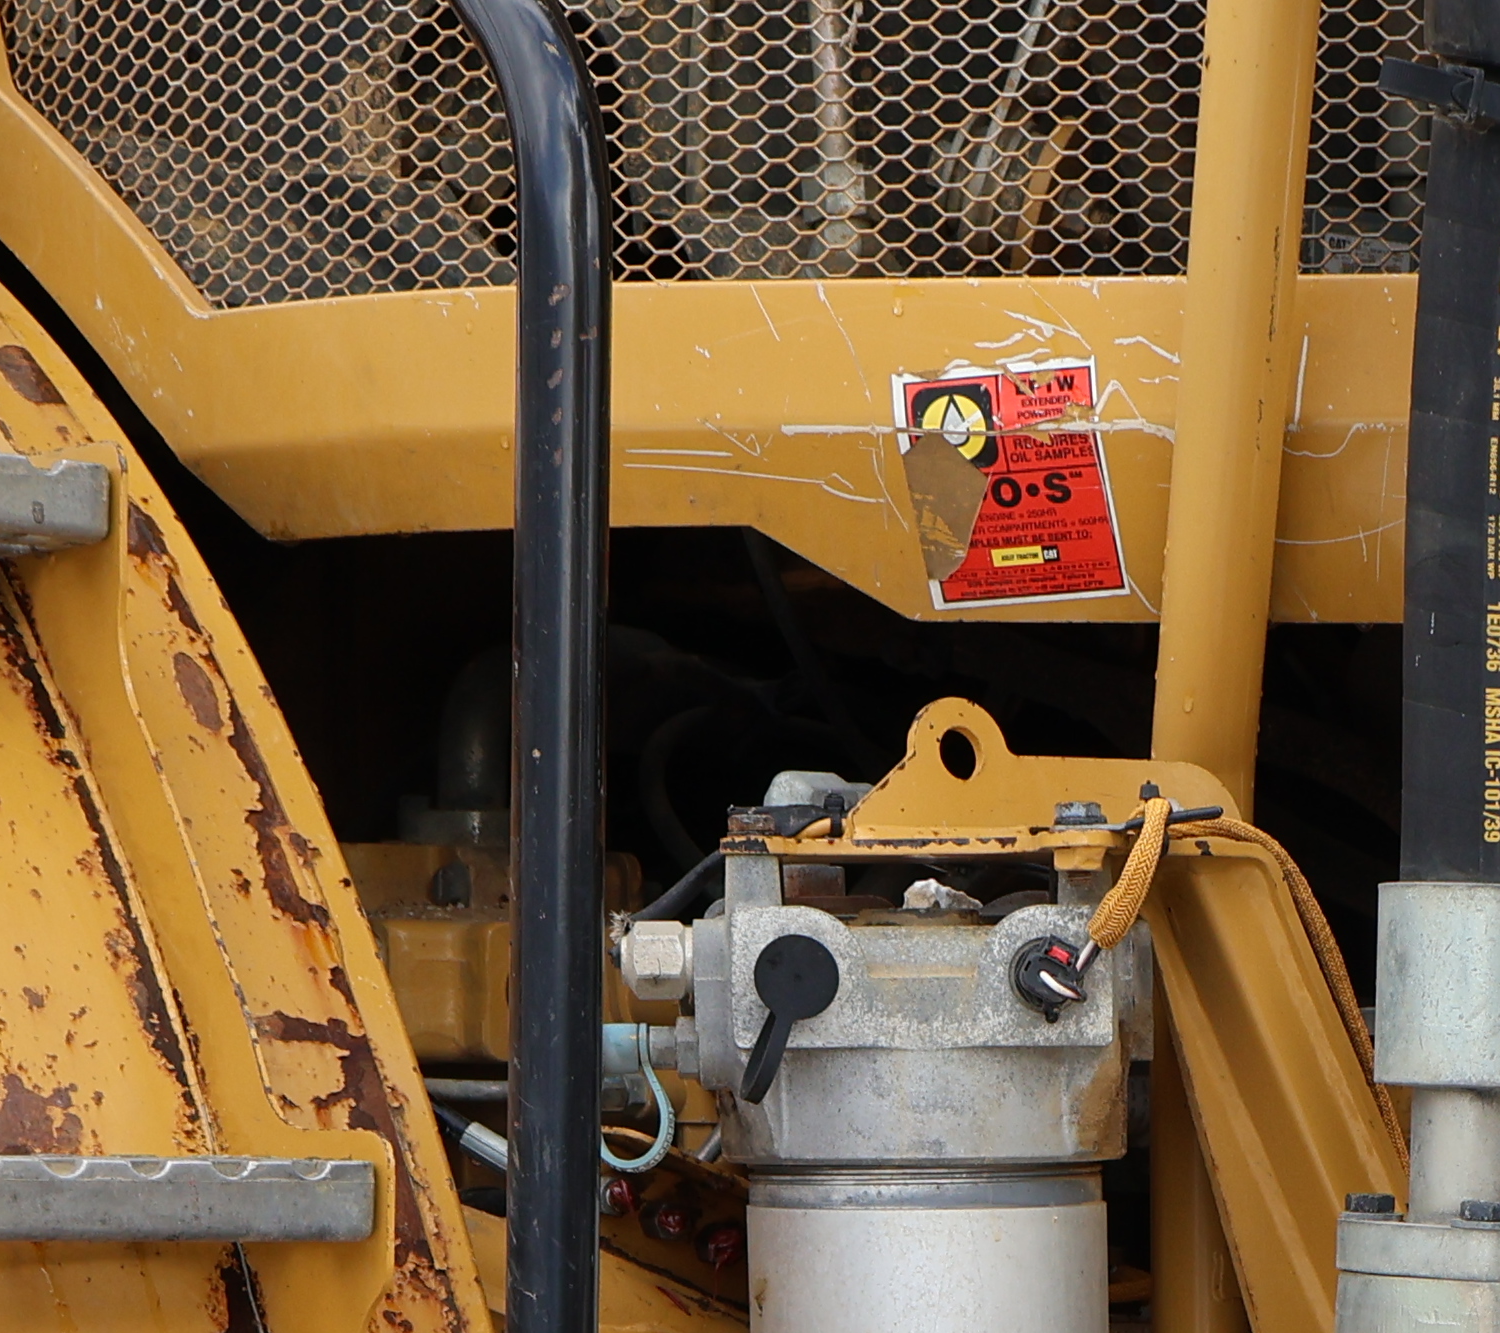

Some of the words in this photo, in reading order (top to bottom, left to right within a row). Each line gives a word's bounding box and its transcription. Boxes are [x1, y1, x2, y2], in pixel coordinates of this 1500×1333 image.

[1021, 395, 1071, 407] EXTENDED
[1010, 451, 1031, 464] OIL
[1035, 446, 1096, 461] SAMPLES
[1488, 515, 1496, 536] 172
[1032, 533, 1046, 543] BE
[1487, 561, 1495, 579] WP
